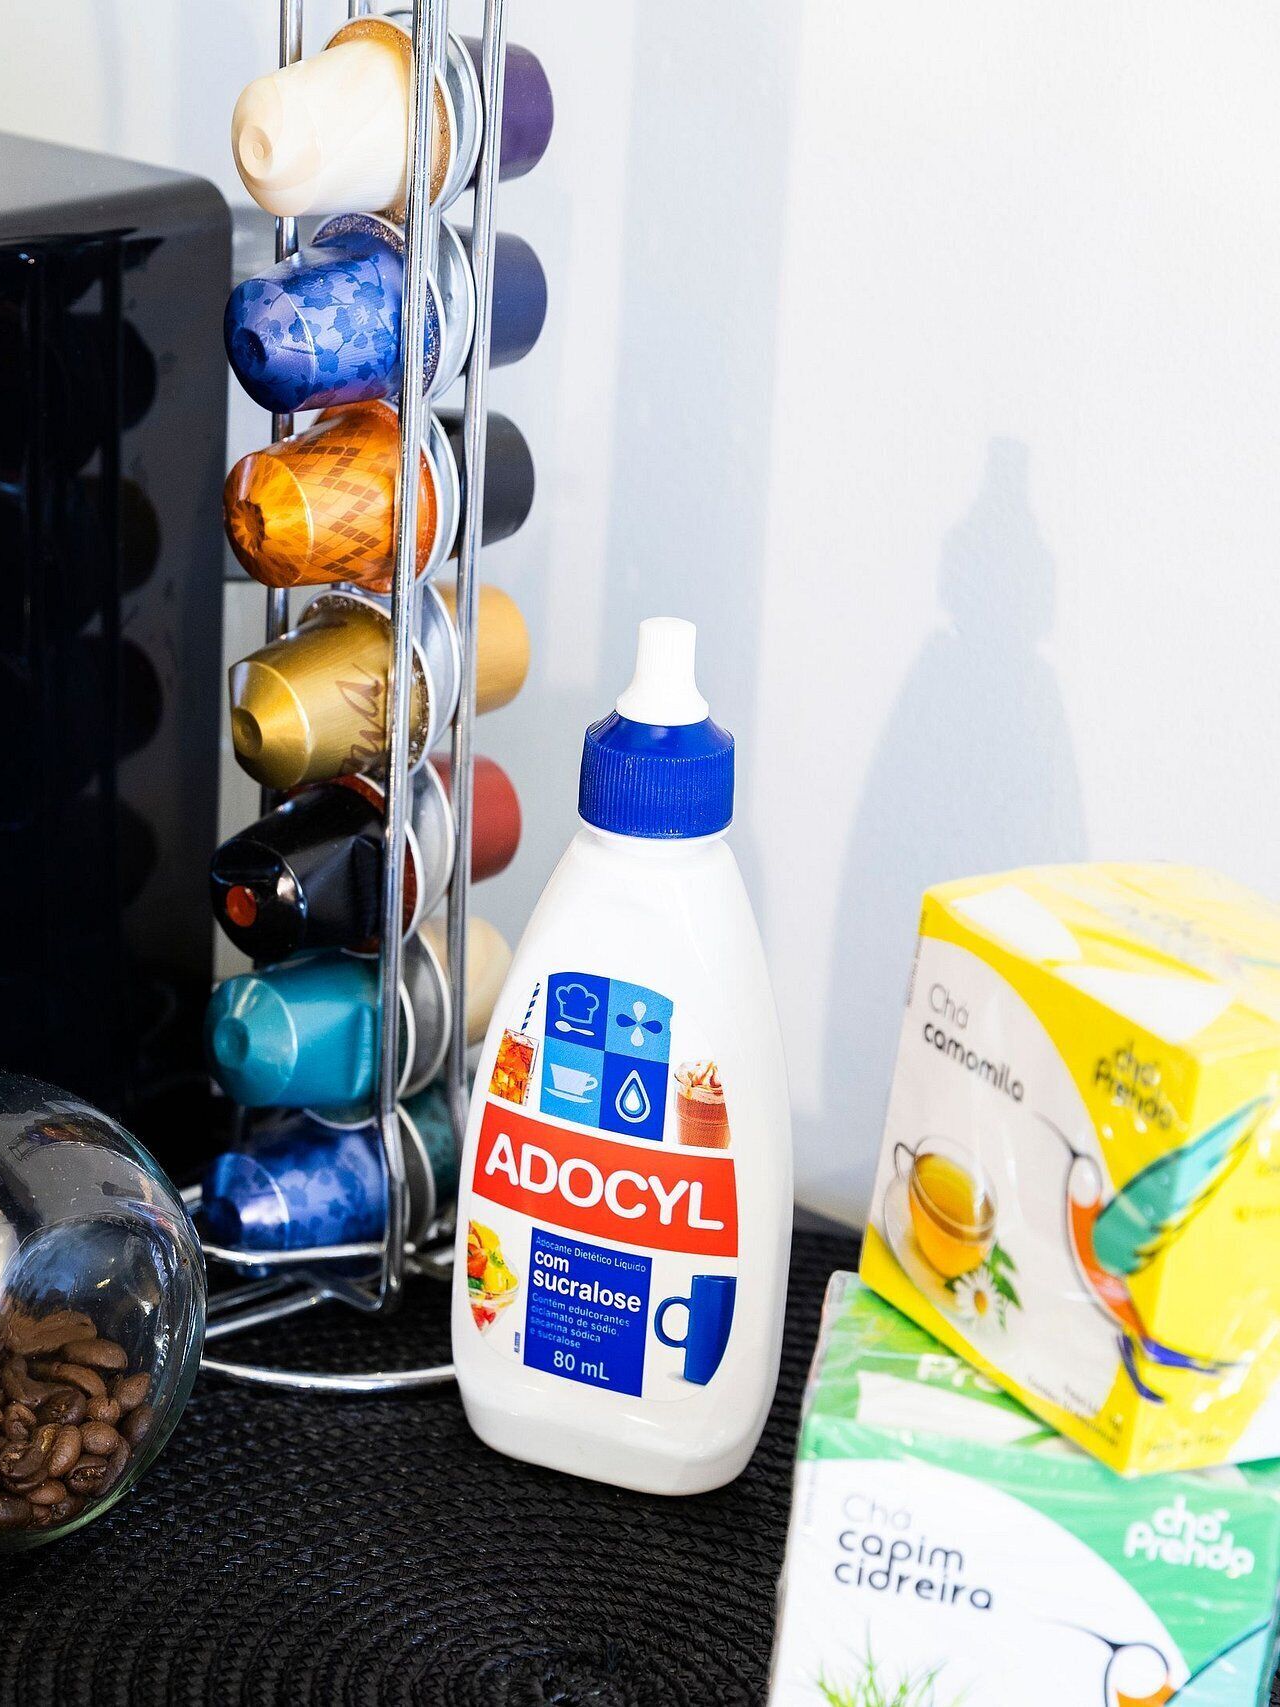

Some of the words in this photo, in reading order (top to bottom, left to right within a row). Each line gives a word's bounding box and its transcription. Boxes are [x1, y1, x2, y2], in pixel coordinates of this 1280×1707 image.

[923, 1022, 1025, 1103] camomila
[485, 1133, 725, 1231] ADOCYL
[534, 1250, 570, 1273] com
[574, 1247, 612, 1265] Dietético
[532, 1269, 642, 1313] sucralose
[530, 1316, 568, 1334] sacarina
[570, 1327, 601, 1343] sódica
[568, 1305, 631, 1328] edulcorantes
[576, 1317, 588, 1328] de
[537, 1329, 581, 1349] sucralose
[553, 1350, 576, 1372] 80
[580, 1361, 610, 1381] mL
[917, 1353, 1002, 1394] Pre
[838, 1529, 963, 1576] capim
[834, 1557, 992, 1609] cidreira
